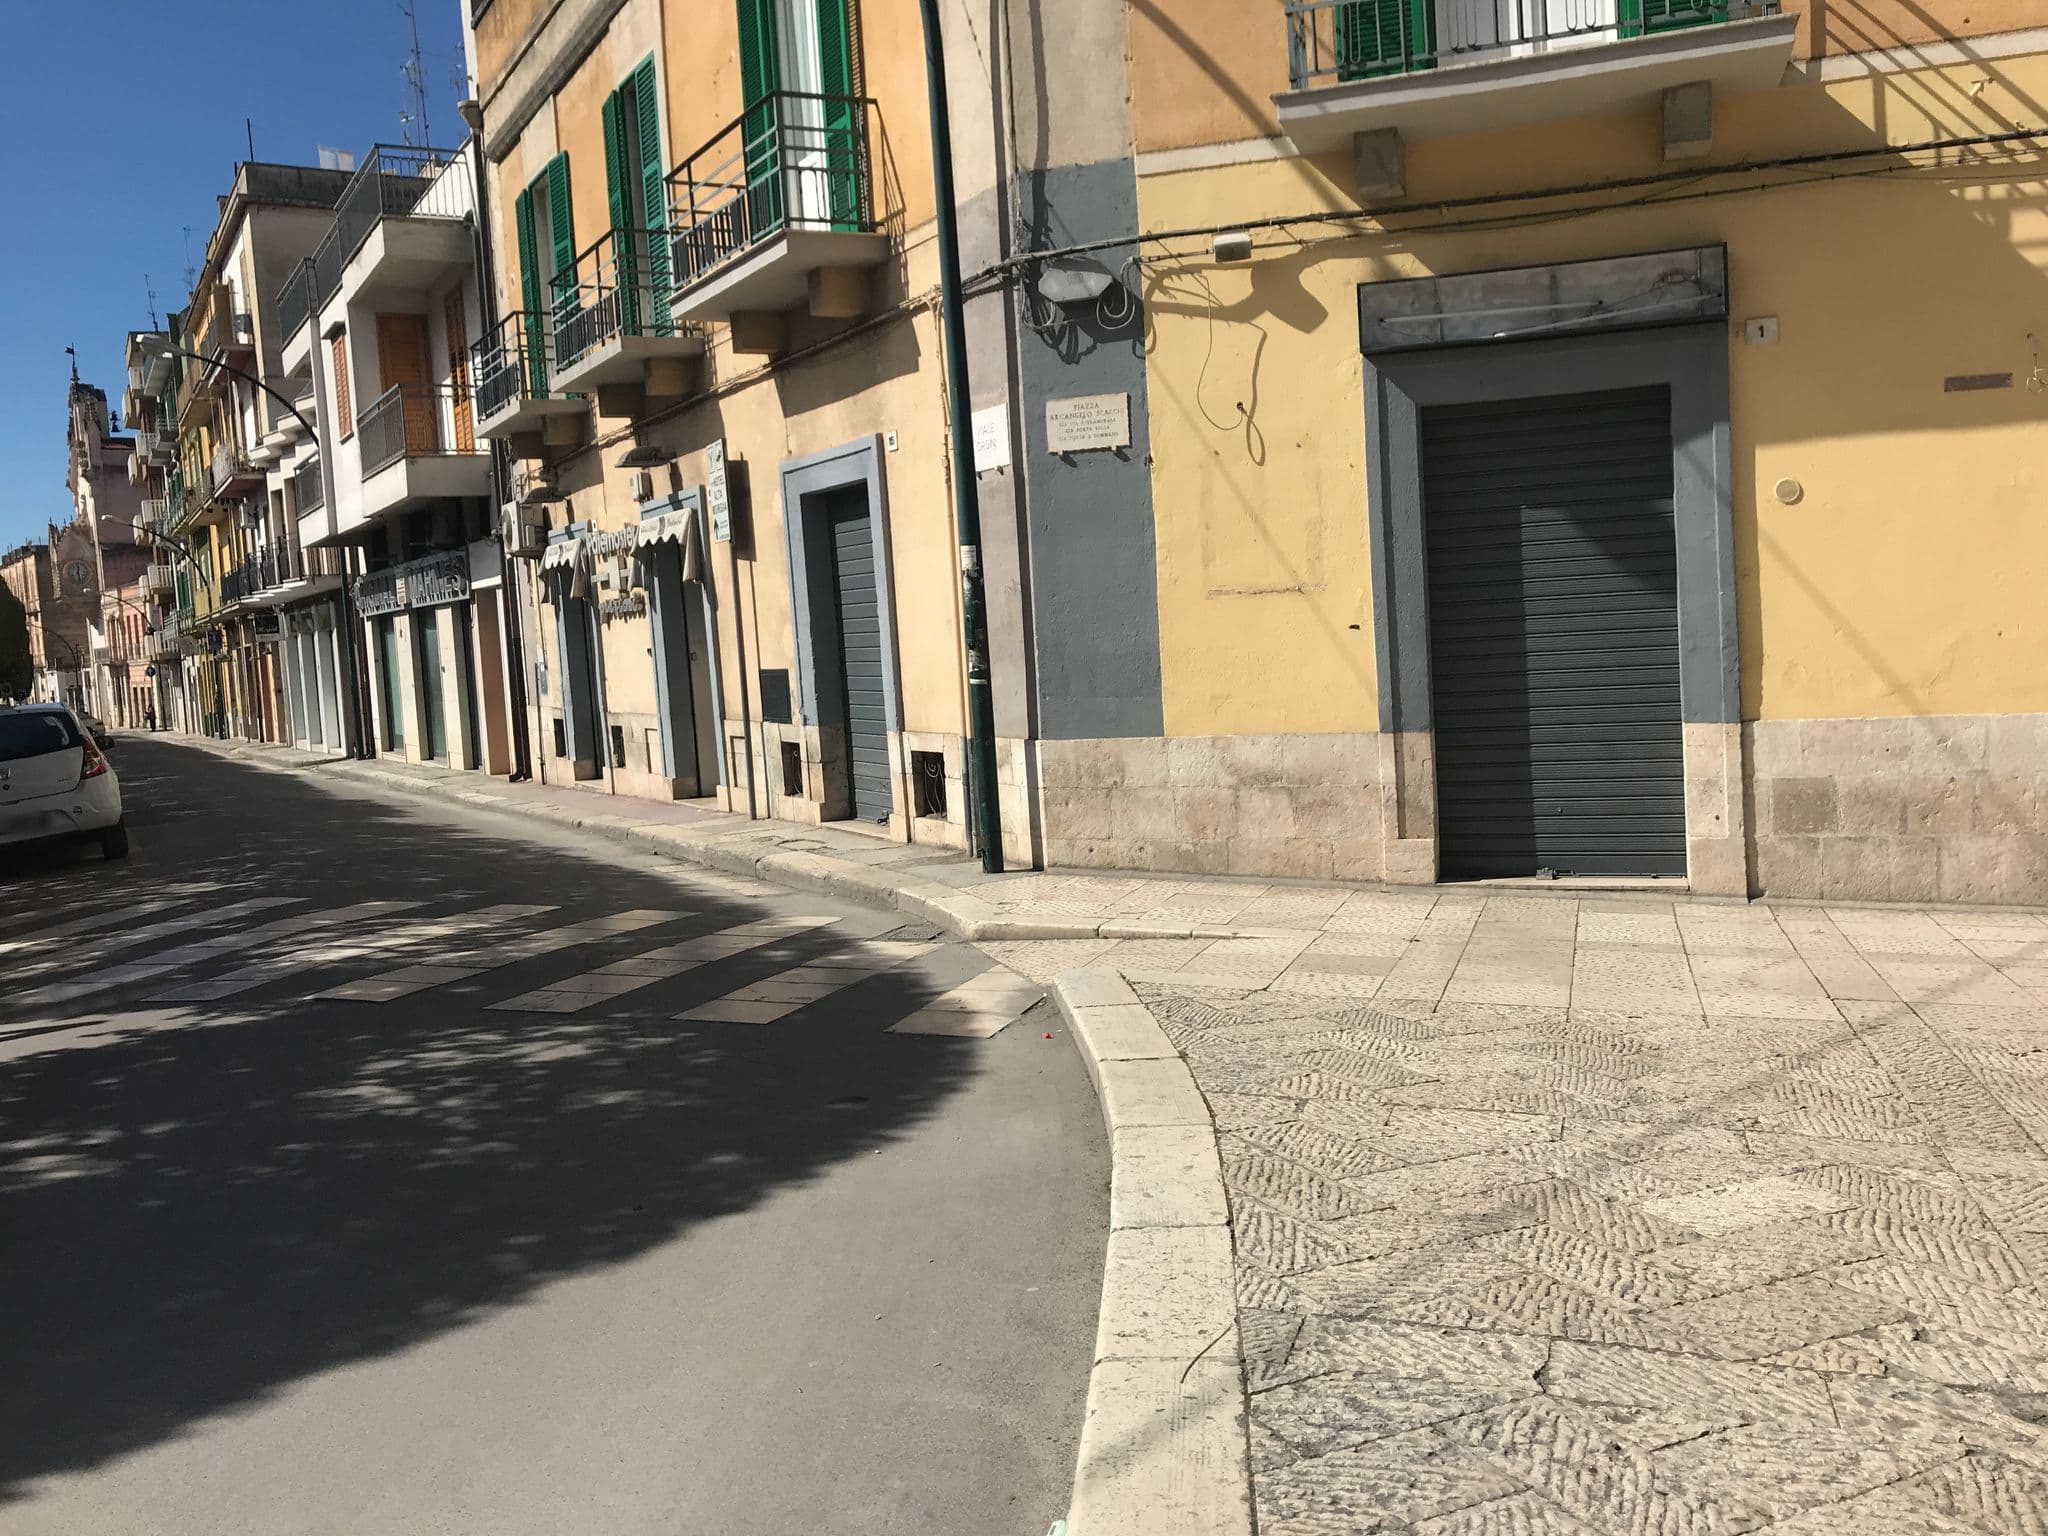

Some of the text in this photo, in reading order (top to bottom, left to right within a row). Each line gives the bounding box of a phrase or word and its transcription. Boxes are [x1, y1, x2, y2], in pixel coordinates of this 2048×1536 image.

[1758, 324, 1764, 338] 1
[1073, 402, 1100, 411] PIAZZA
[1051, 410, 1093, 421] ARCANGELO
